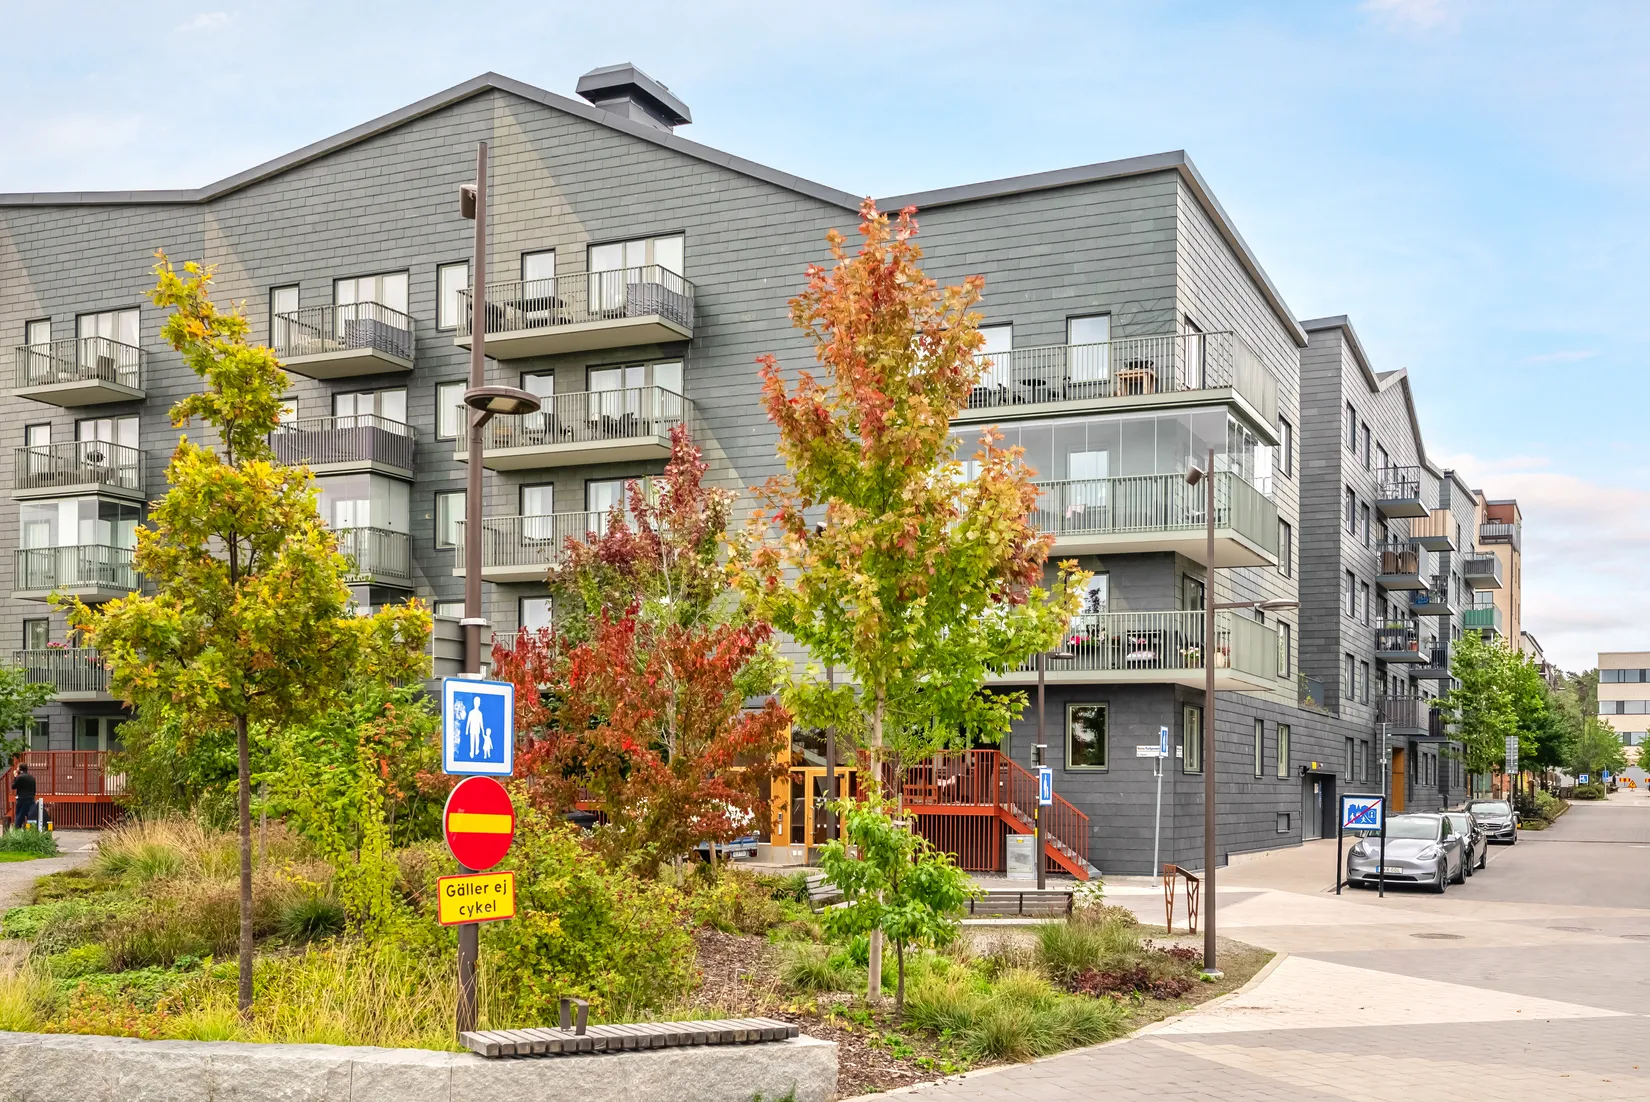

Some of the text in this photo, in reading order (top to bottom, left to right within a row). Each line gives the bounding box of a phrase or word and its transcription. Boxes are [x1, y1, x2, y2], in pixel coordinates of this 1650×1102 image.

[446, 879, 507, 897] Gäller ej
[459, 899, 496, 918] cykel
